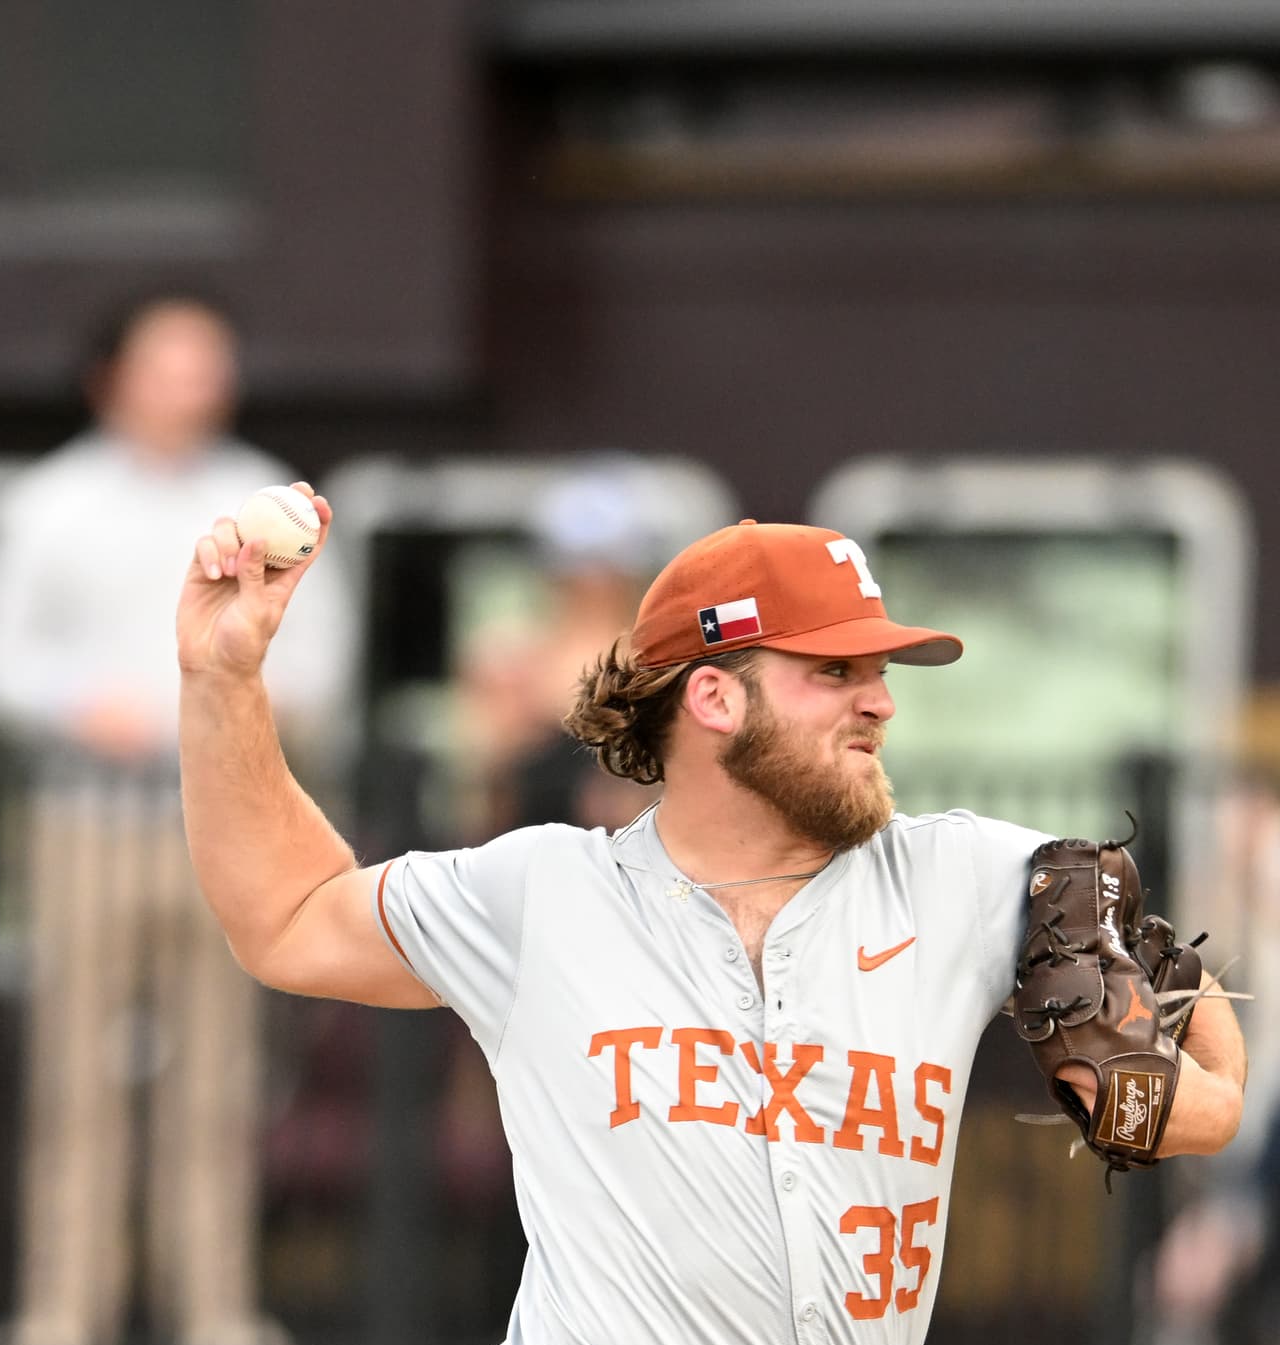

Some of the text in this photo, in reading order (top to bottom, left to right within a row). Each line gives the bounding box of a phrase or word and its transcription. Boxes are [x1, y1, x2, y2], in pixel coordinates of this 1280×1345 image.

[826, 538, 881, 600] T
[1102, 873, 1120, 900] 1:8
[587, 1026, 952, 1167] TEXAS
[1116, 1078, 1147, 1140] Rawlings
[839, 1196, 939, 1320] 35
